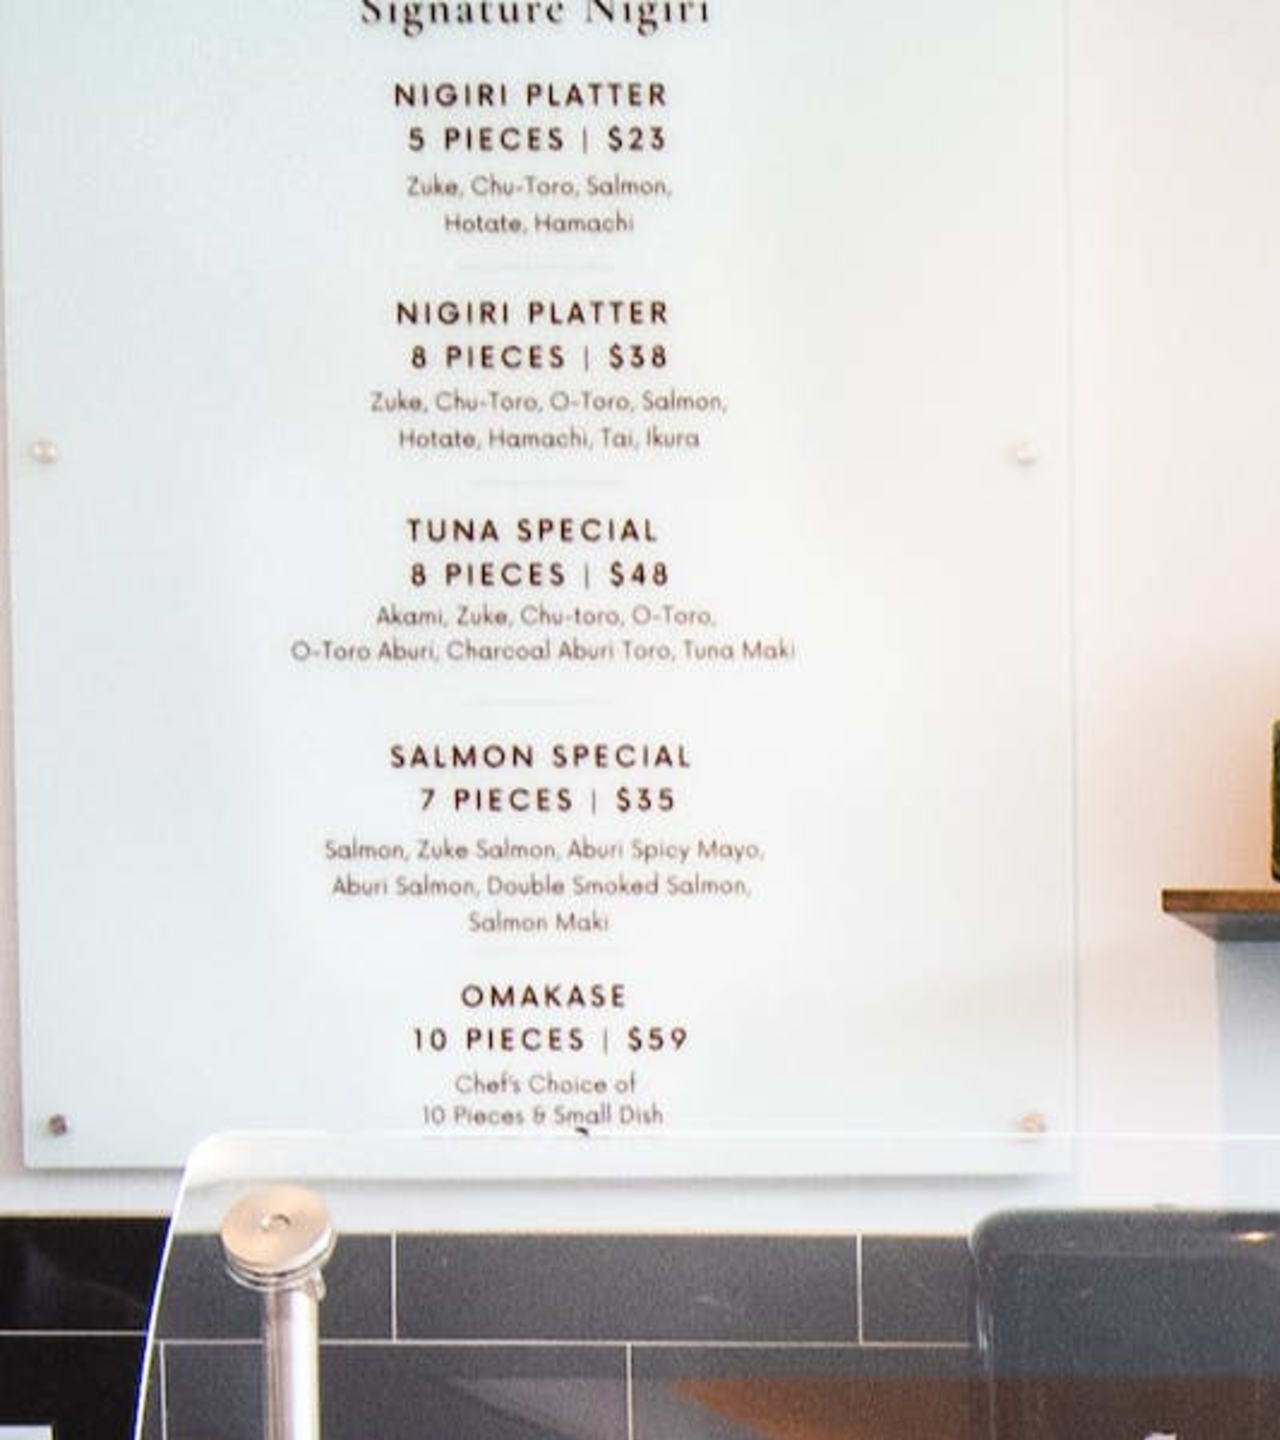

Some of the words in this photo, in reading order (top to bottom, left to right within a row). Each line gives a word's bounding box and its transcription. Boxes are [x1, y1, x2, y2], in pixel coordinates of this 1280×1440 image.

[393, 81, 508, 110] NIGIRI
[525, 80, 667, 109] PLATTER
[407, 125, 427, 154] 5
[443, 125, 565, 153] PIECES
[606, 123, 667, 155] $23
[533, 209, 635, 235] Hamachi
[395, 299, 510, 327] NIGIRI
[527, 299, 669, 327] PLATTER
[408, 344, 429, 371] 8
[444, 343, 566, 371] PIECES
[608, 341, 668, 373] $38
[645, 424, 701, 450] Ikura
[405, 517, 501, 545] TUNA
[516, 516, 659, 545] SPECIAL
[409, 561, 428, 589] 8
[444, 560, 566, 588] PIECES
[608, 559, 669, 590] $48
[289, 638, 372, 663] O-Toro
[445, 637, 552, 662] Charcoal
[557, 636, 615, 662] Aburi
[683, 638, 735, 662] Tuna
[741, 636, 796, 661] Maki
[389, 742, 535, 770] SALMON
[551, 742, 692, 770] SPECIAL
[419, 786, 437, 813] 7
[453, 786, 573, 814] PIECES
[615, 785, 676, 815] $35
[416, 836, 470, 861] Zuke
[566, 835, 624, 860] Aburi
[631, 837, 691, 865] Spicy
[331, 872, 389, 898] Aburi
[486, 872, 566, 897] Double
[572, 871, 660, 897] Smoked
[468, 909, 549, 933] Salmon
[555, 909, 609, 933] Maki
[459, 982, 626, 1010] OMAKASE
[412, 1026, 448, 1053] 10
[465, 1026, 585, 1053] PIECES
[626, 1024, 688, 1054] $59
[527, 1071, 608, 1095] Choice
[613, 1069, 637, 1095] of
